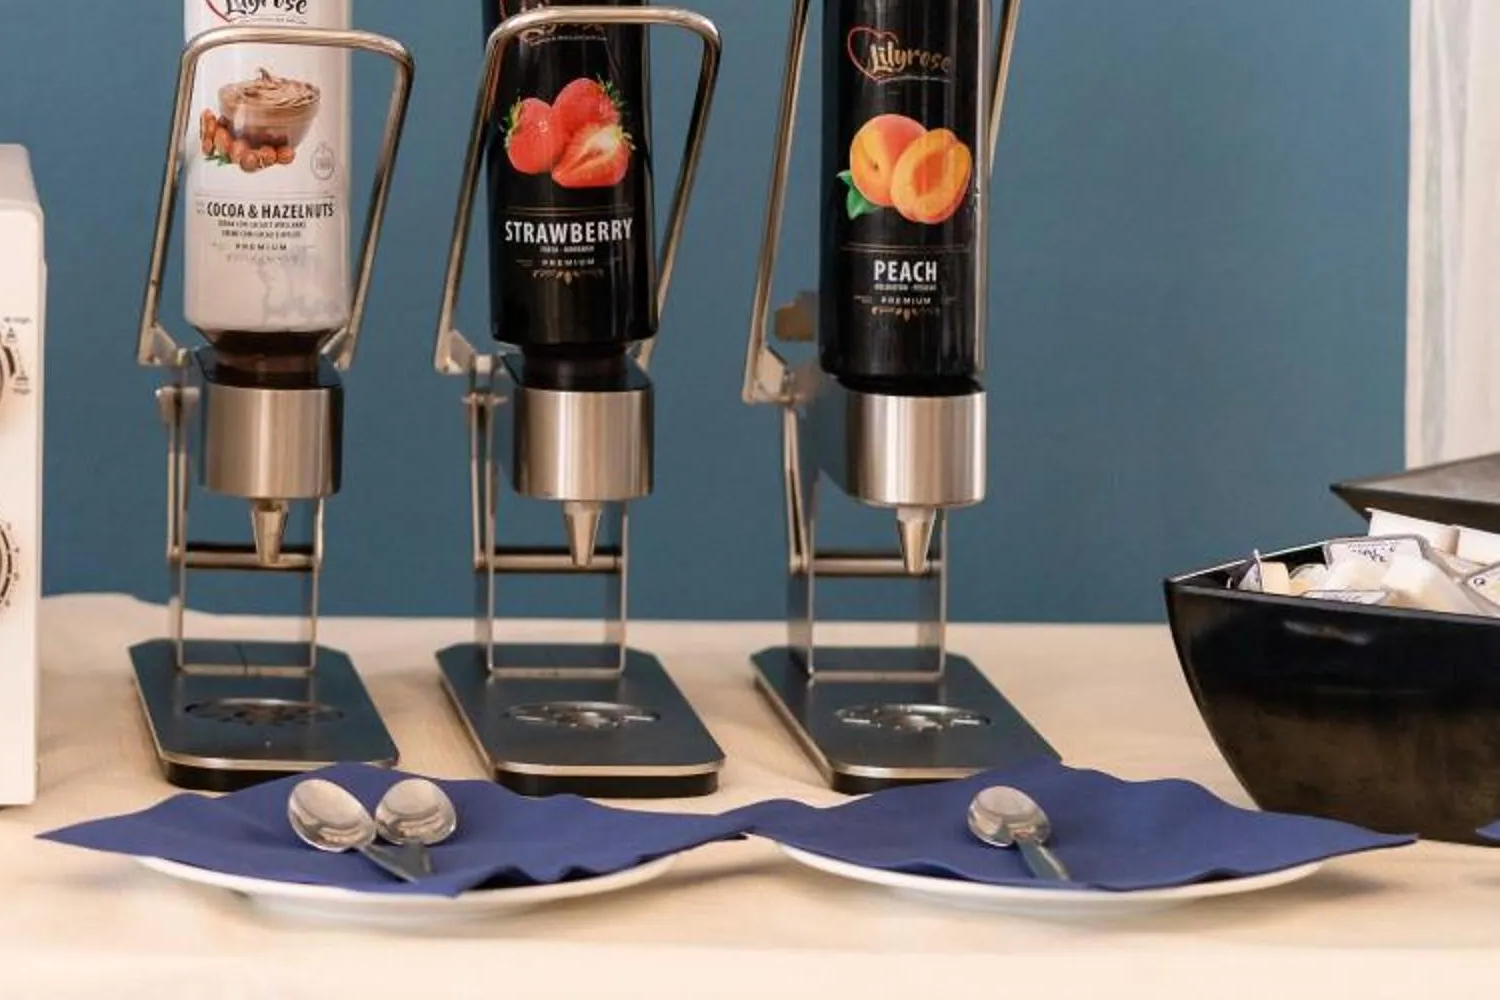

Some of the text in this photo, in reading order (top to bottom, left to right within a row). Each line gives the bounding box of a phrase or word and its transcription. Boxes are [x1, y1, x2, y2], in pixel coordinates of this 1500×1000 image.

[868, 41, 952, 75] Lilyrose
[207, 201, 335, 219] COCOA & HAZELNUTS
[504, 216, 633, 244] STRAWBERRY
[235, 243, 287, 251] PREMIUM
[541, 258, 595, 267] PREMIUM
[873, 260, 937, 282] PEACH
[881, 296, 931, 305] PREMIUM
